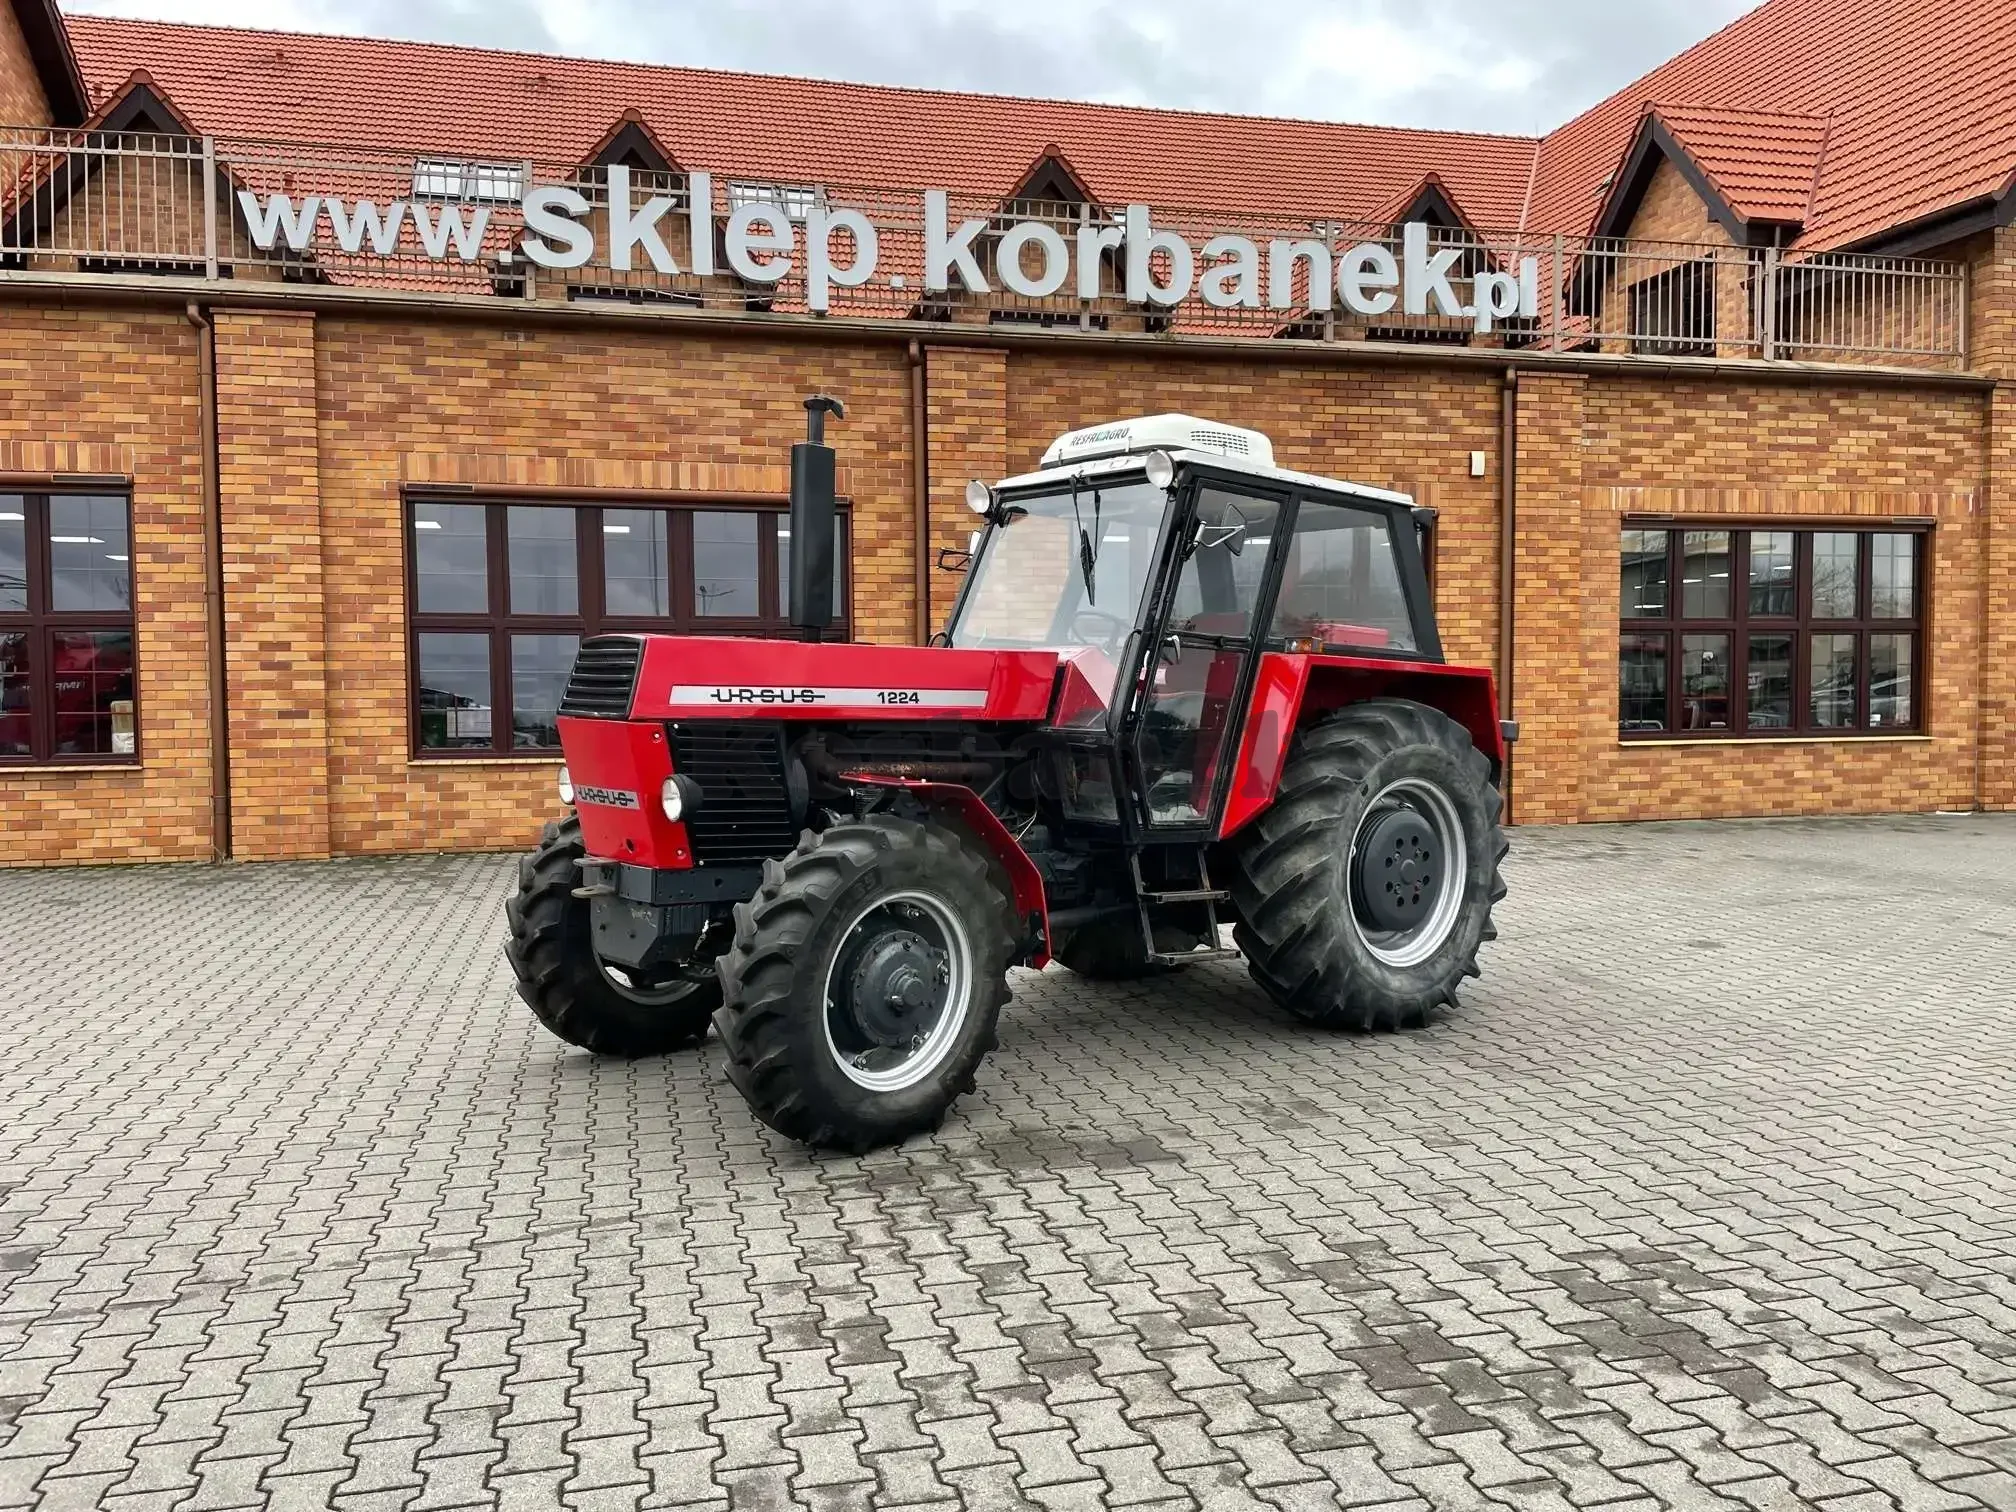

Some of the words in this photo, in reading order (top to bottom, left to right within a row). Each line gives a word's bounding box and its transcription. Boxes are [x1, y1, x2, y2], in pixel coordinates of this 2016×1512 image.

[711, 688, 826, 703] URSUS
[877, 691, 920, 704] 1224
[578, 786, 635, 806] URSUS
